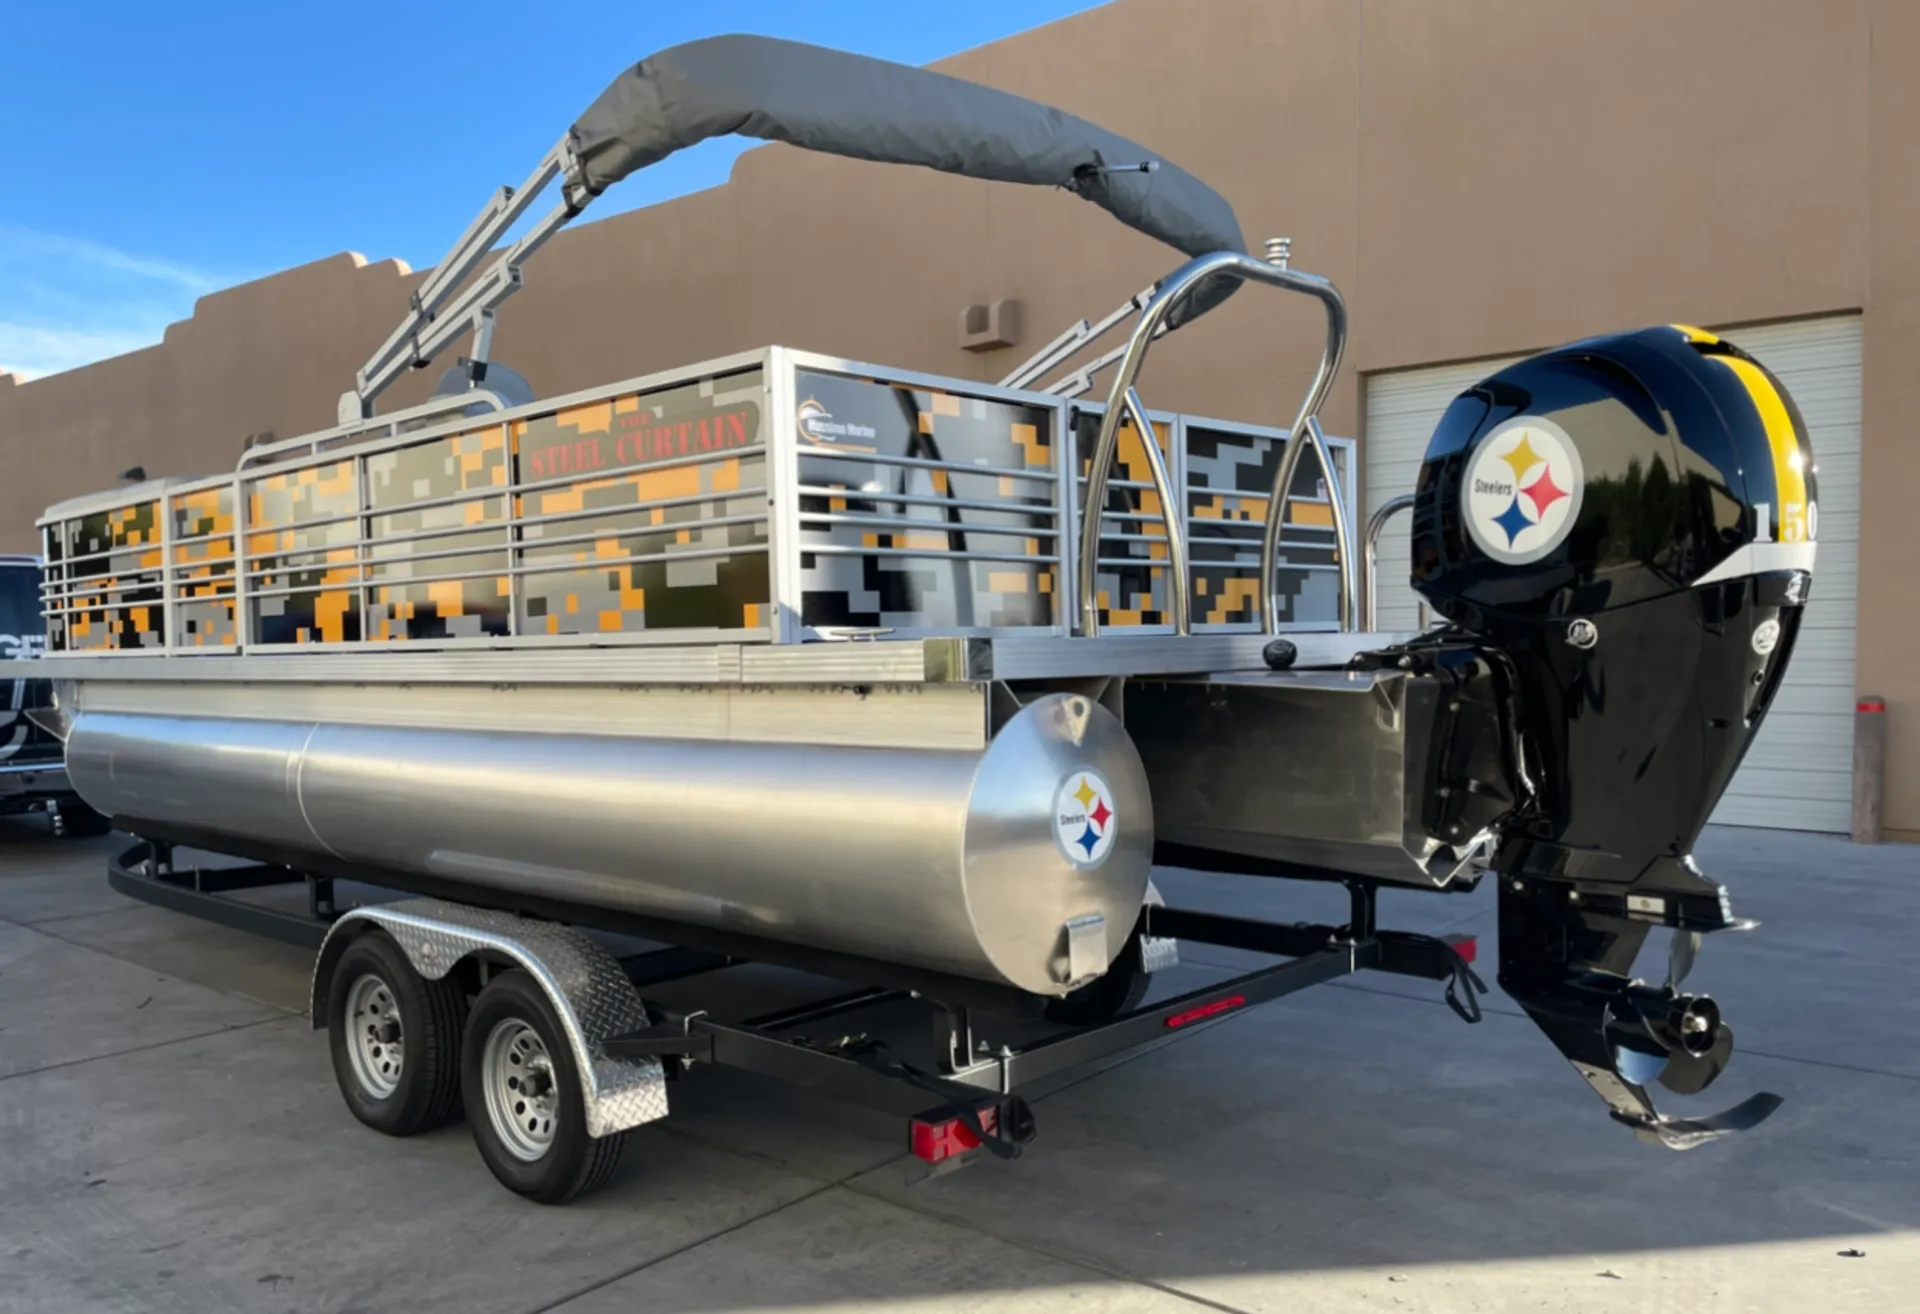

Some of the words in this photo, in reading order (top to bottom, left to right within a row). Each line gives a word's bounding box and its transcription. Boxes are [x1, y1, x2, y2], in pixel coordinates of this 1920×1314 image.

[531, 438, 606, 478] STEEL
[616, 411, 748, 464] CURTAIN
[1474, 478, 1512, 496] Steelers
